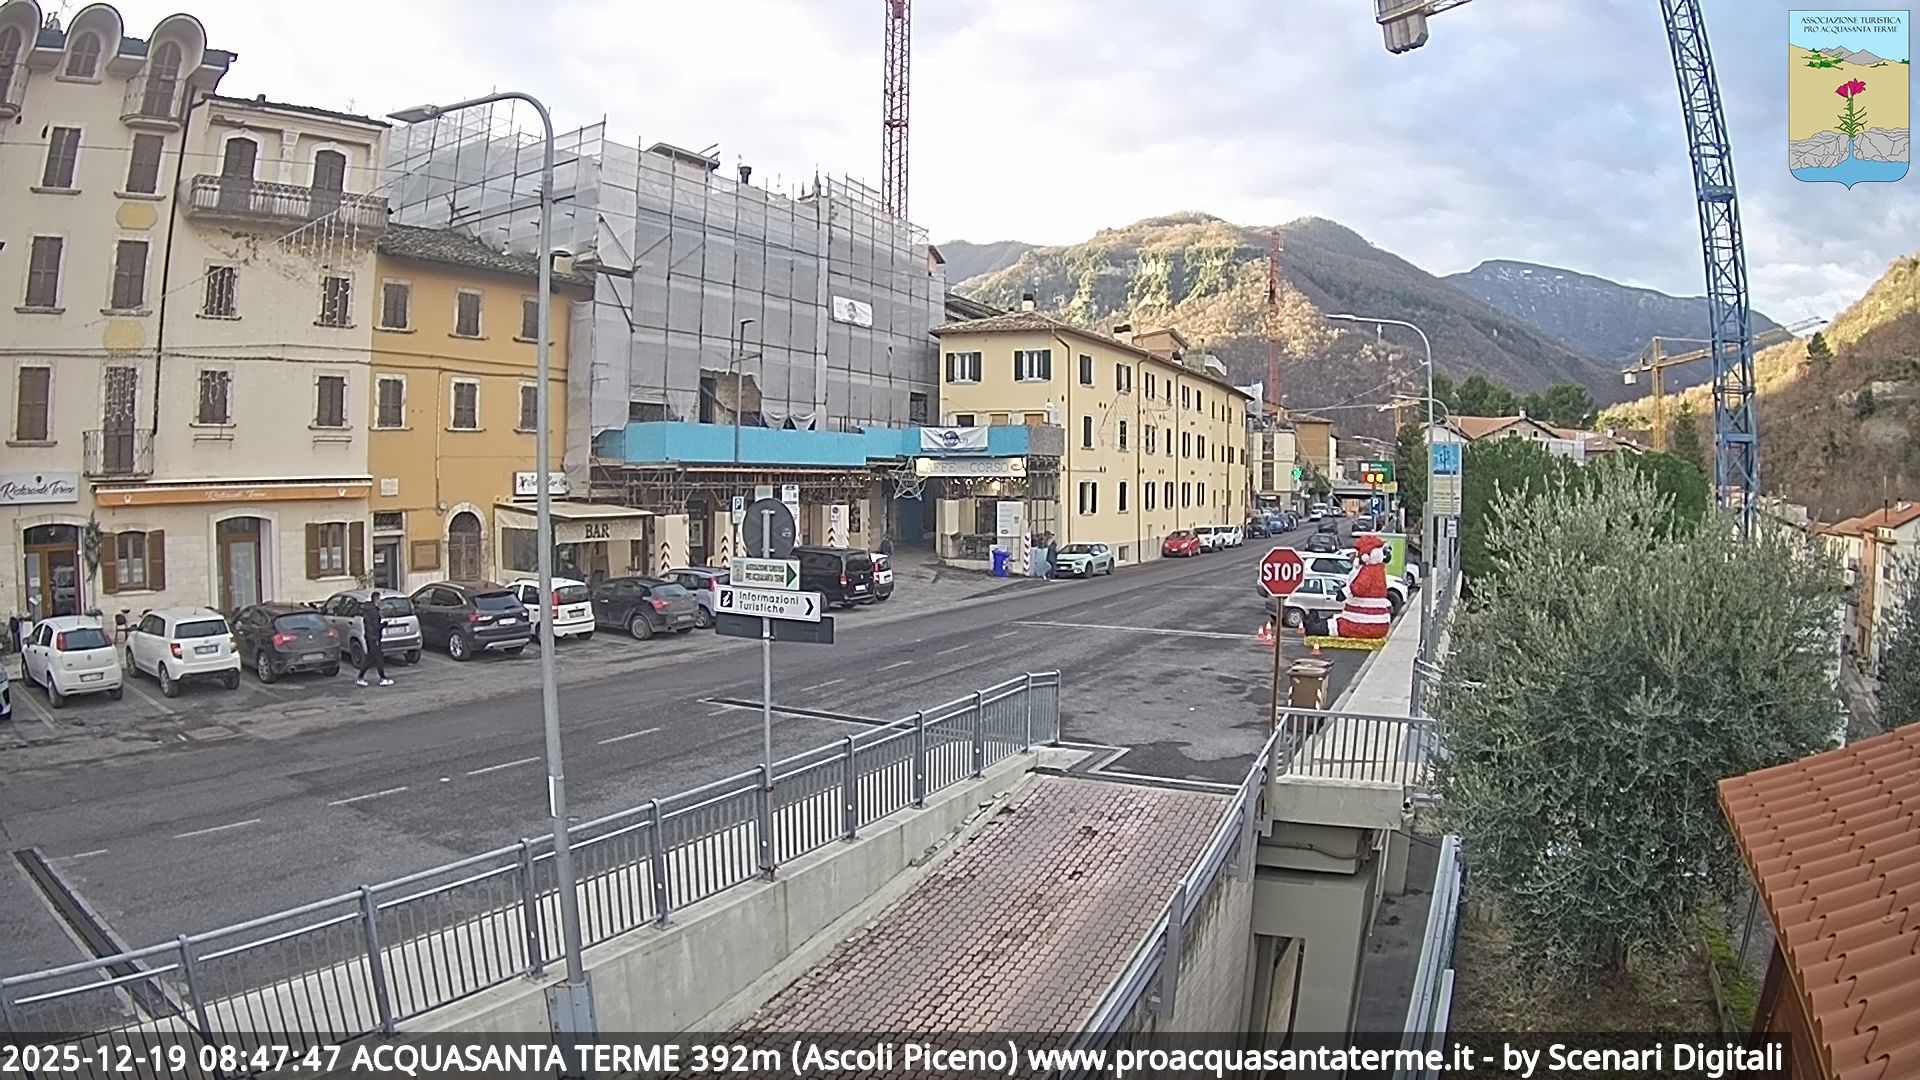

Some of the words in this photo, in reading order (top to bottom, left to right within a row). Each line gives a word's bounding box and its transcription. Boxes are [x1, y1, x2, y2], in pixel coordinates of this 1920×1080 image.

[969, 462, 1008, 473] CORSO
[585, 523, 610, 539] BAR
[1263, 562, 1302, 582] STOP
[739, 592, 799, 605] Informazioni
[739, 602, 785, 614] Turistiche
